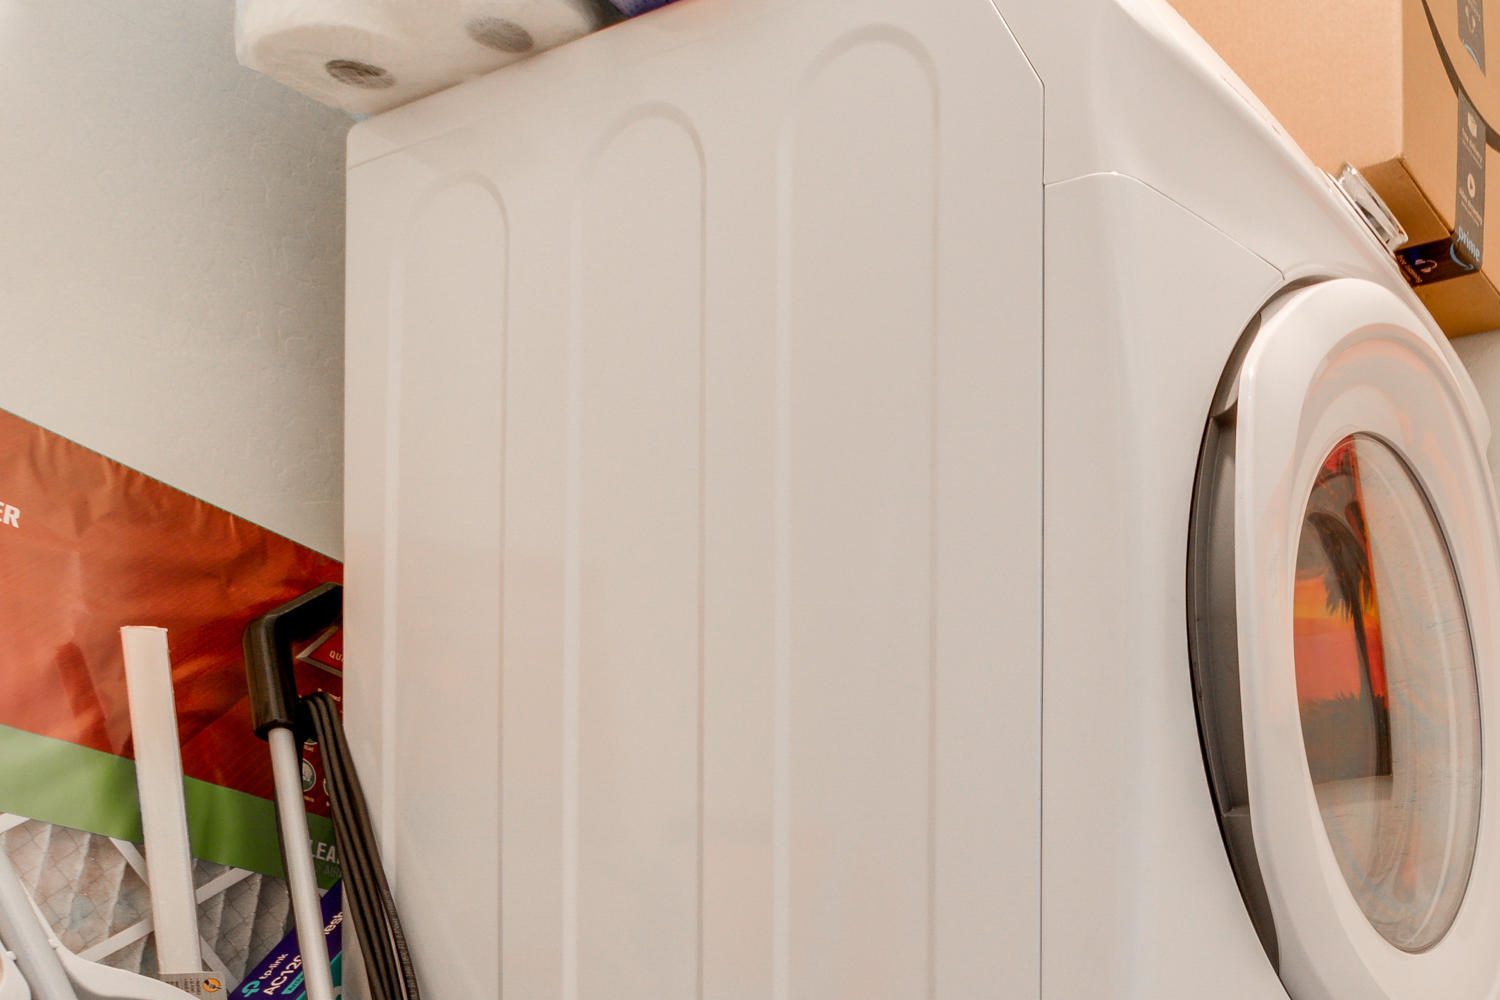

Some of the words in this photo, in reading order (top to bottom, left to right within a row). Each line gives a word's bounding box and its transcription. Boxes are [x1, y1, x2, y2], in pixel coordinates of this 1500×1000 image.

[1456, 226, 1480, 262] prime
[329, 650, 343, 662] QU
[323, 911, 343, 934] esh
[259, 953, 289, 980] tp-link
